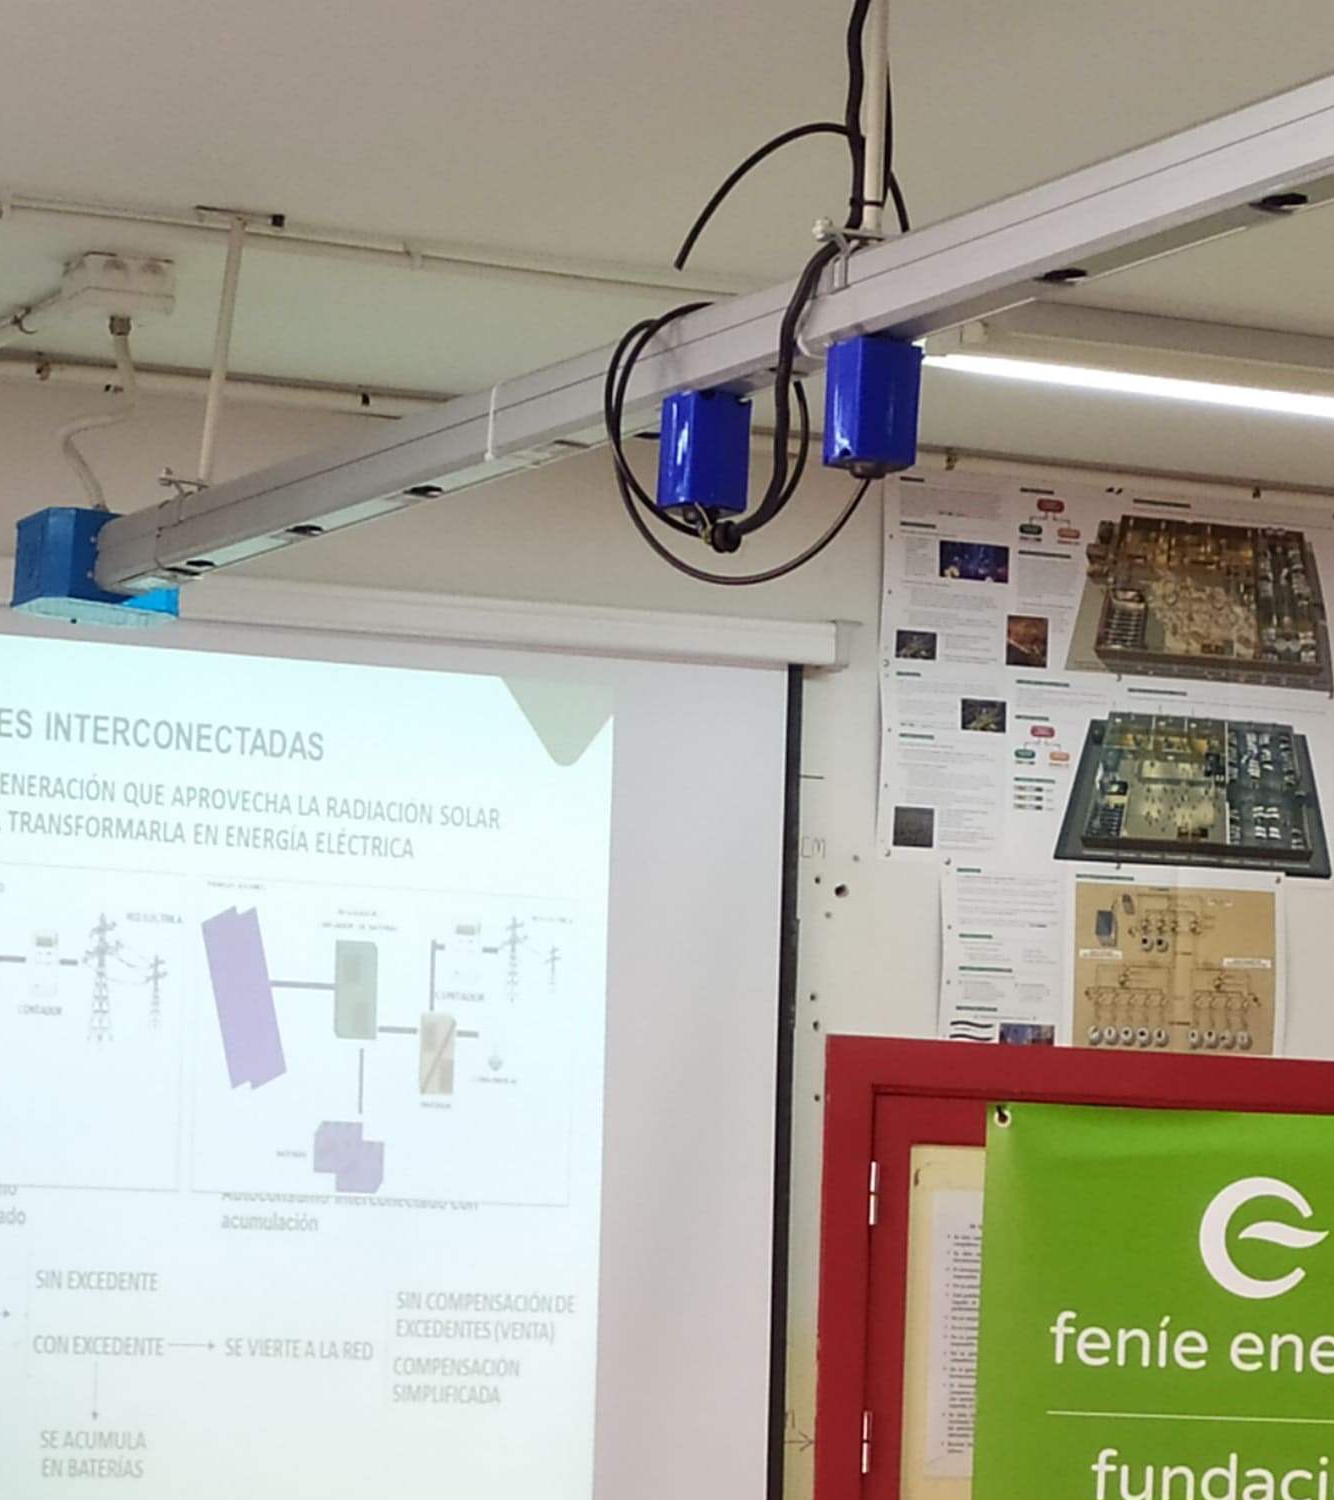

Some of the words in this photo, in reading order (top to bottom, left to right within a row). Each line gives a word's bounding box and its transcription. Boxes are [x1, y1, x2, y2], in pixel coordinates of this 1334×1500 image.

[45, 711, 324, 761] INTERCONECTADAS
[123, 783, 164, 808] QUE
[171, 785, 291, 815] APROVECHA
[298, 795, 320, 818] LA
[327, 797, 433, 825] RADIACIÓN
[440, 805, 500, 829] SOLAR
[8, 810, 185, 844] TRANSFORMARLA
[194, 823, 217, 846] EN
[225, 825, 308, 853] ENERGÍA
[316, 829, 414, 859] ELÉCTRICA
[221, 1212, 318, 1231] acumulación
[36, 1270, 62, 1290] SIN
[67, 1271, 158, 1292] EXCEDENTE
[397, 1292, 421, 1310] SIN
[426, 1292, 553, 1313] COMPENSACIÓN
[557, 1294, 575, 1313] DE
[396, 1319, 492, 1340] EXCEDENTES
[494, 1321, 555, 1344] (VENTA)
[1050, 1310, 1208, 1370] feníe
[32, 1335, 68, 1355] CON
[72, 1336, 164, 1357] EXCEDENTE
[225, 1338, 242, 1357] SE
[248, 1339, 300, 1358] VIERTE
[305, 1340, 315, 1358] A
[320, 1340, 338, 1360] LA
[343, 1341, 373, 1361] RED
[393, 1356, 520, 1377] COMPENSACIÓN
[392, 1384, 501, 1405] SIMPLIFICADA
[40, 1430, 58, 1449] SE
[63, 1431, 147, 1451] ACUMULA
[41, 1458, 64, 1477] EN
[68, 1455, 143, 1479] BATERÍAS
